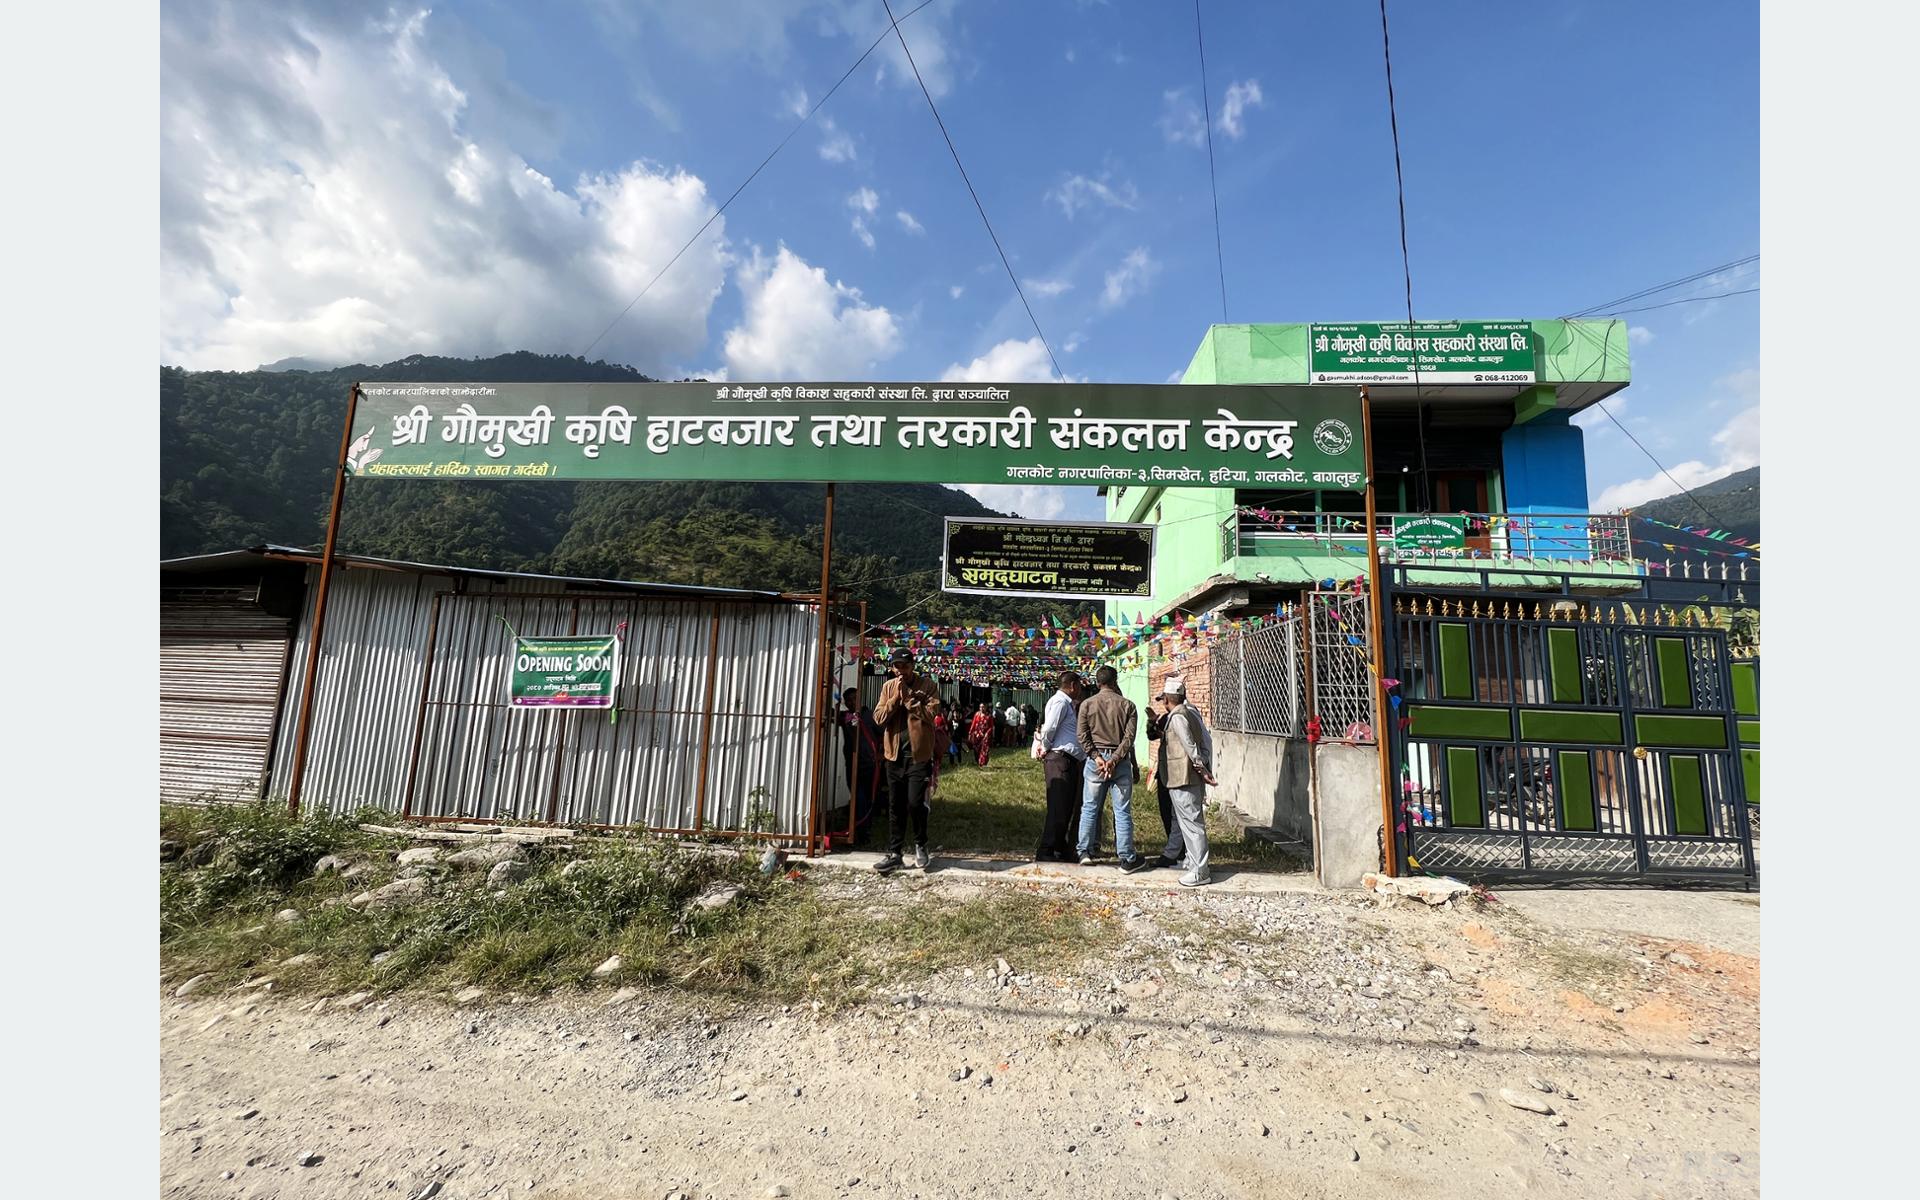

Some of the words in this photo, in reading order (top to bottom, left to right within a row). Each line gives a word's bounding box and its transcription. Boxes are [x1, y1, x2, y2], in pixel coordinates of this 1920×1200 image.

[716, 388, 730, 399] श्री
[732, 386, 768, 402] गौमुखी
[771, 388, 793, 402] कृषि
[833, 388, 876, 401] सहकारी
[878, 388, 908, 400] संस्था
[911, 387, 928, 400] लि.
[392, 405, 432, 445] श्री
[442, 403, 556, 458] गौमुखी
[565, 405, 638, 458] कृषि
[646, 415, 800, 454] हाटबजार
[810, 414, 887, 448] तथा
[897, 406, 1037, 450] तरकारी
[1047, 408, 1191, 451] संकलन
[1202, 408, 1298, 460] केन्द्र
[434, 461, 471, 475] हार्दिक
[473, 464, 511, 476] स्वागत
[1007, 464, 1055, 478] गलकोट
[1209, 467, 1250, 484] हटिया,
[1255, 468, 1309, 484] गलकोट,
[1312, 471, 1361, 487] बागलुङ
[517, 654, 572, 672] OPENING
[576, 653, 611, 671] SOON
